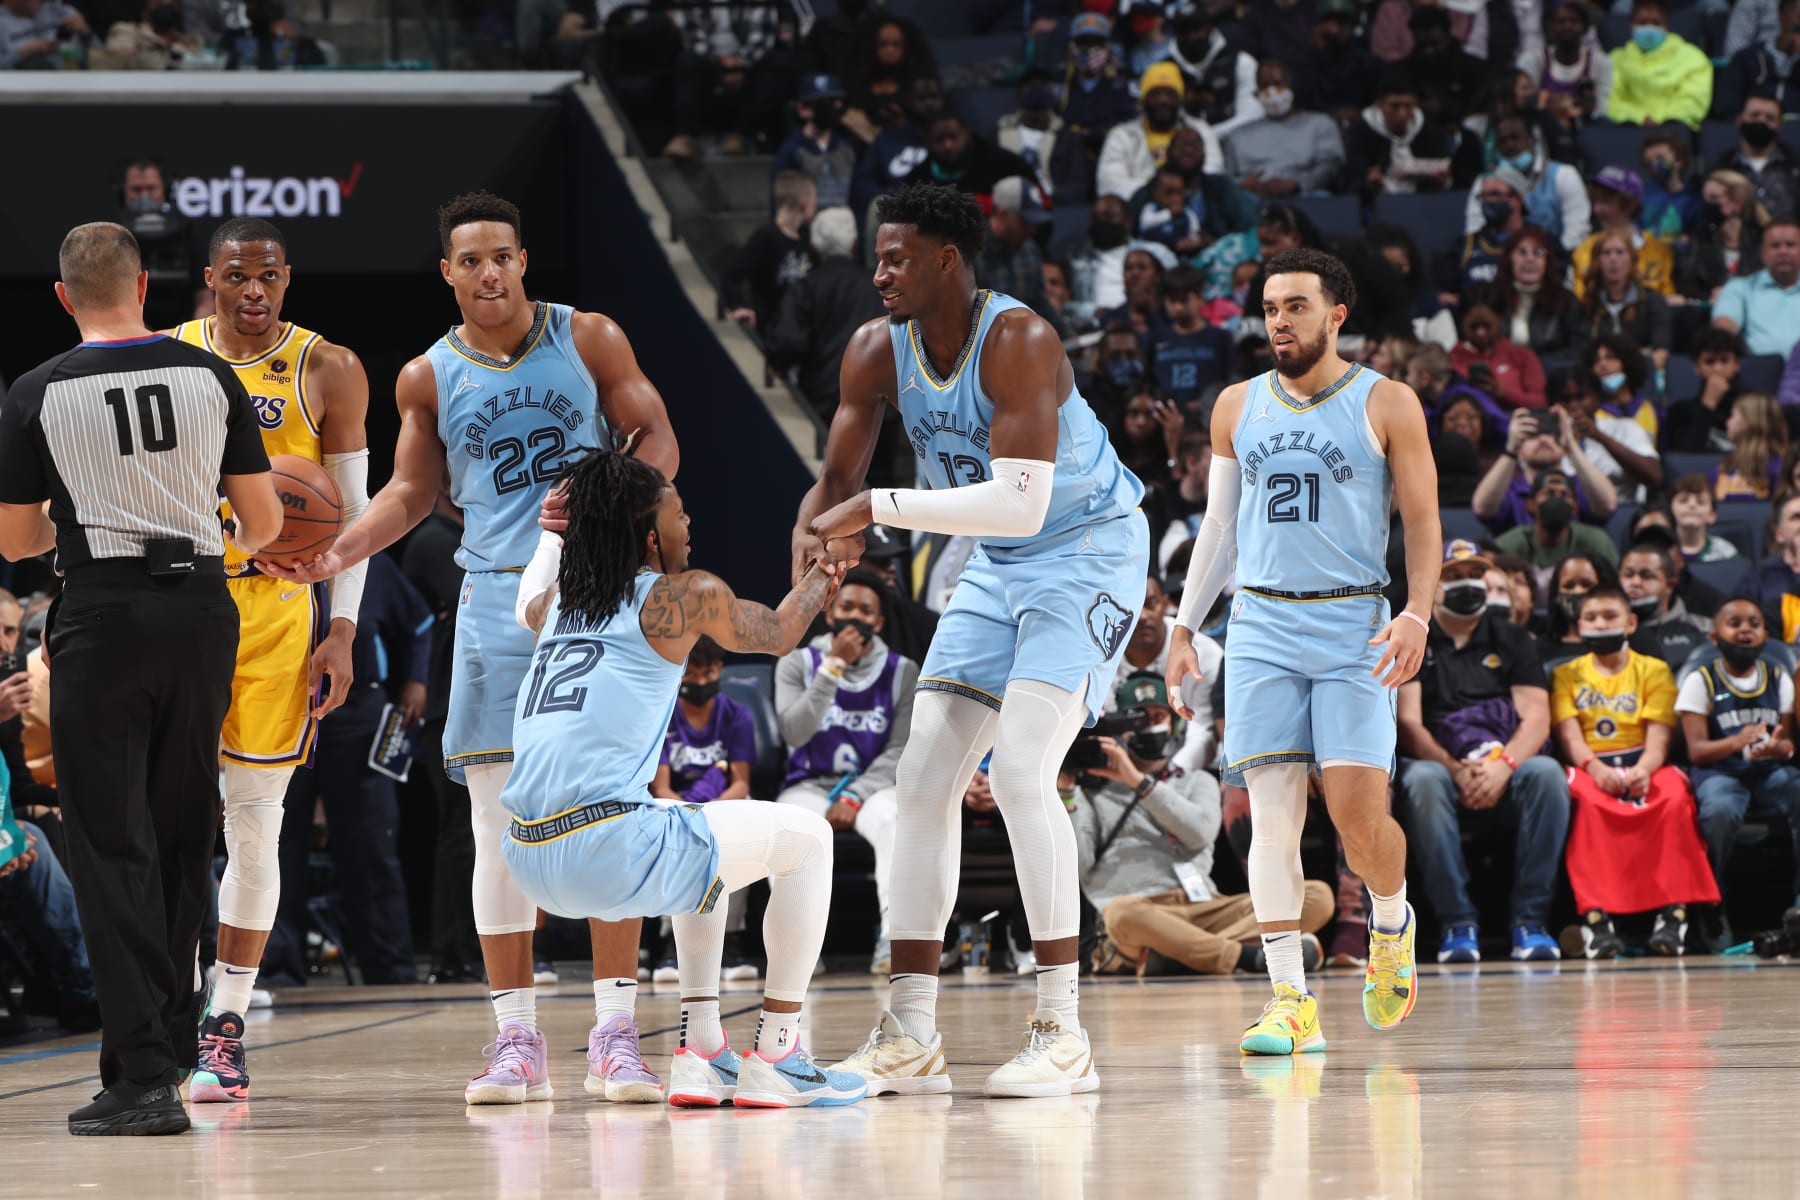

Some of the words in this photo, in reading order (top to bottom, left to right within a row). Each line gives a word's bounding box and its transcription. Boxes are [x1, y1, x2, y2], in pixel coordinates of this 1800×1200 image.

[163, 165, 341, 217] erizon
[262, 373, 291, 384] bibigo
[104, 384, 178, 456] 10
[465, 386, 584, 460] GRIZZLIES
[911, 410, 990, 460] GRIZZLIE
[488, 426, 571, 496] 22
[1244, 430, 1354, 486] GRIZZLIES
[1267, 472, 1320, 524] 21
[522, 639, 605, 720] 12
[821, 705, 888, 735] AKERS
